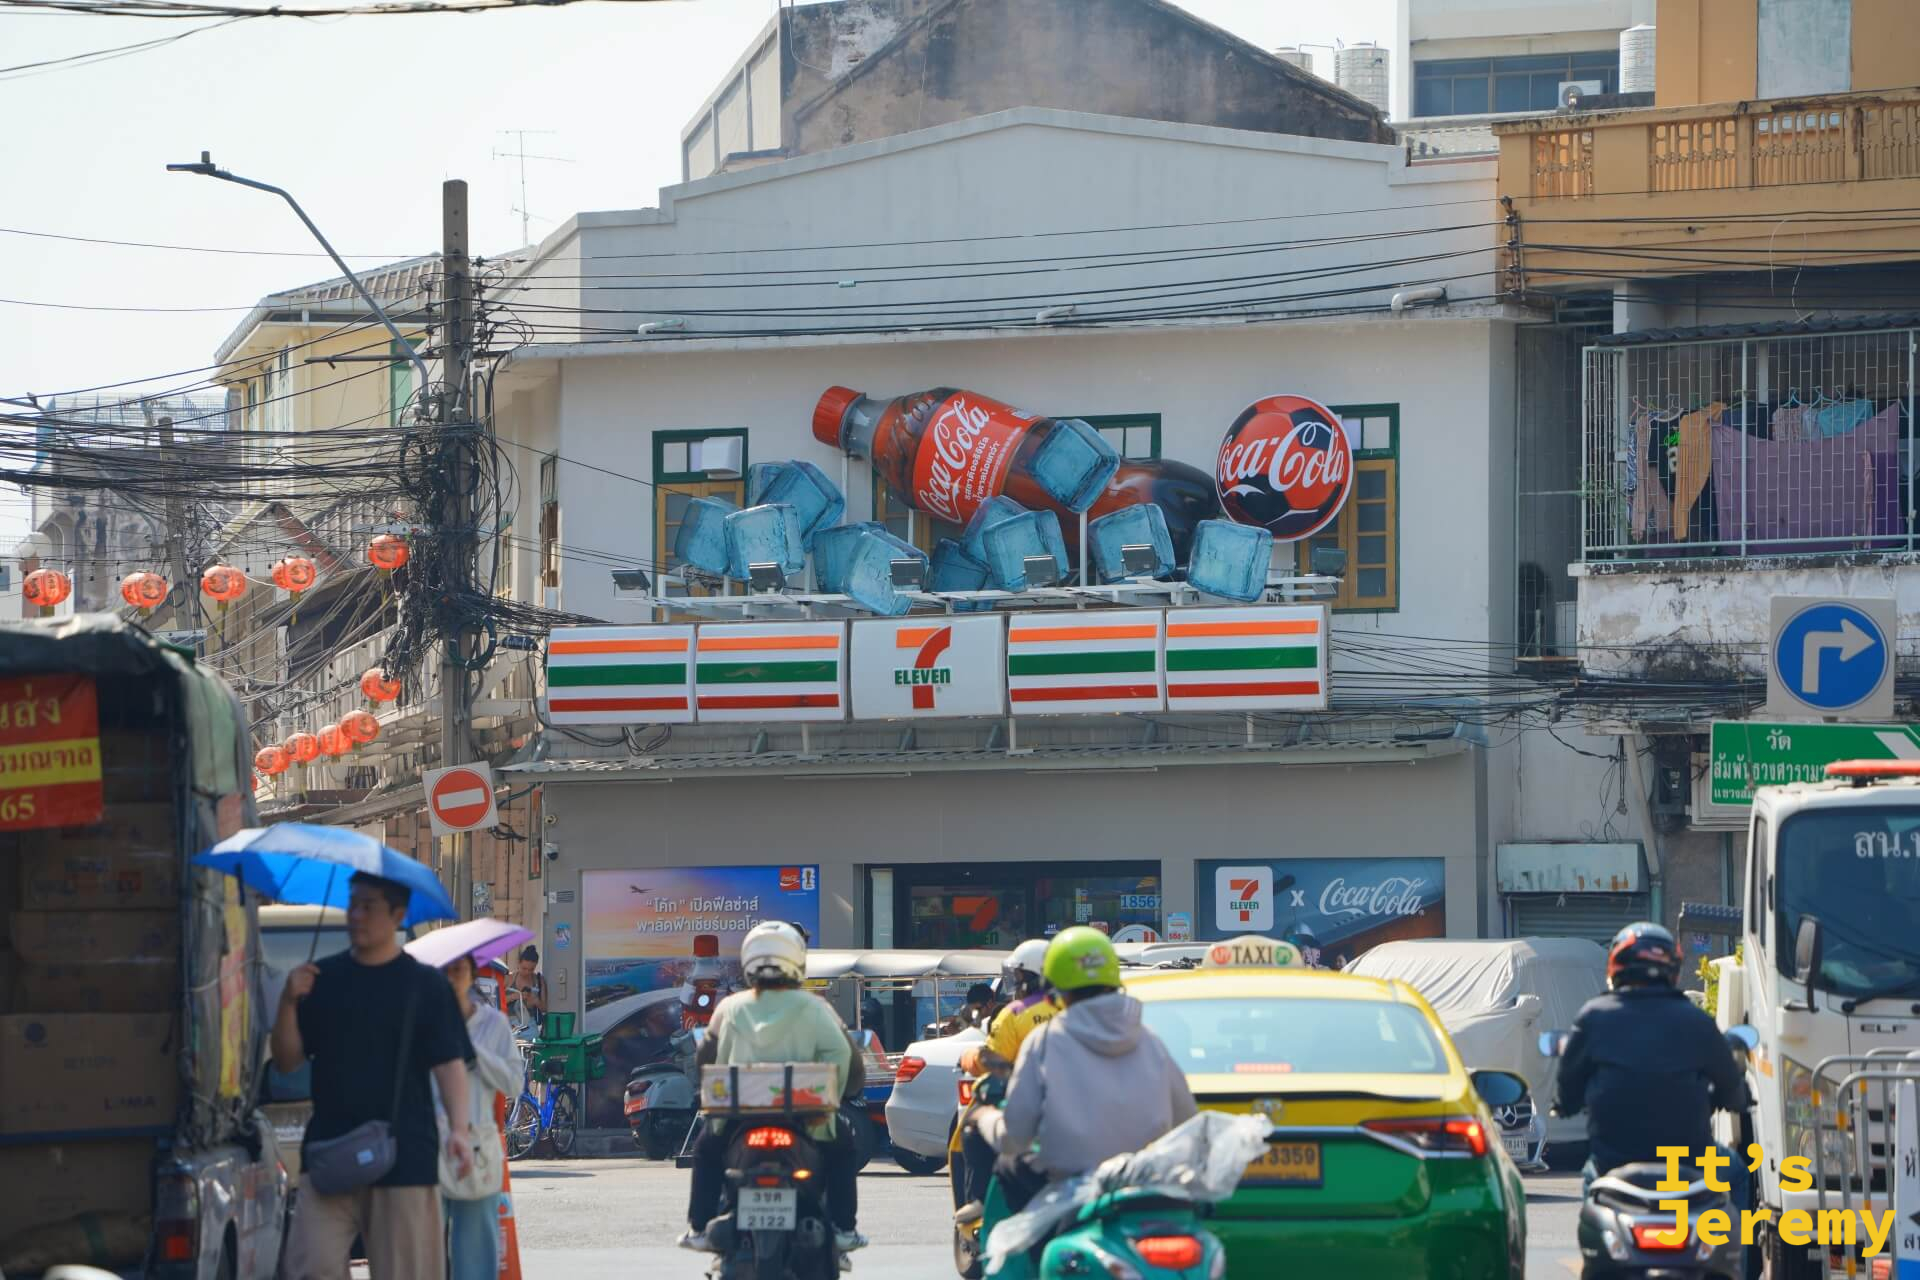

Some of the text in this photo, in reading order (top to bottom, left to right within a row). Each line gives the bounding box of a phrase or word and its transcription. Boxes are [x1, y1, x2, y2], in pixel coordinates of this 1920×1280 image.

[920, 397, 989, 523] Coca-Cola
[896, 626, 951, 709] 7
[1767, 729, 1791, 750] วัด
[0, 748, 93, 774] มณฑล
[1319, 877, 1424, 916] Coca-Cola
[636, 915, 767, 932] พาลัดฟ้าเชียร์บอลโล
[1232, 946, 1272, 964] TAXI
[747, 1216, 785, 1227] 2122
